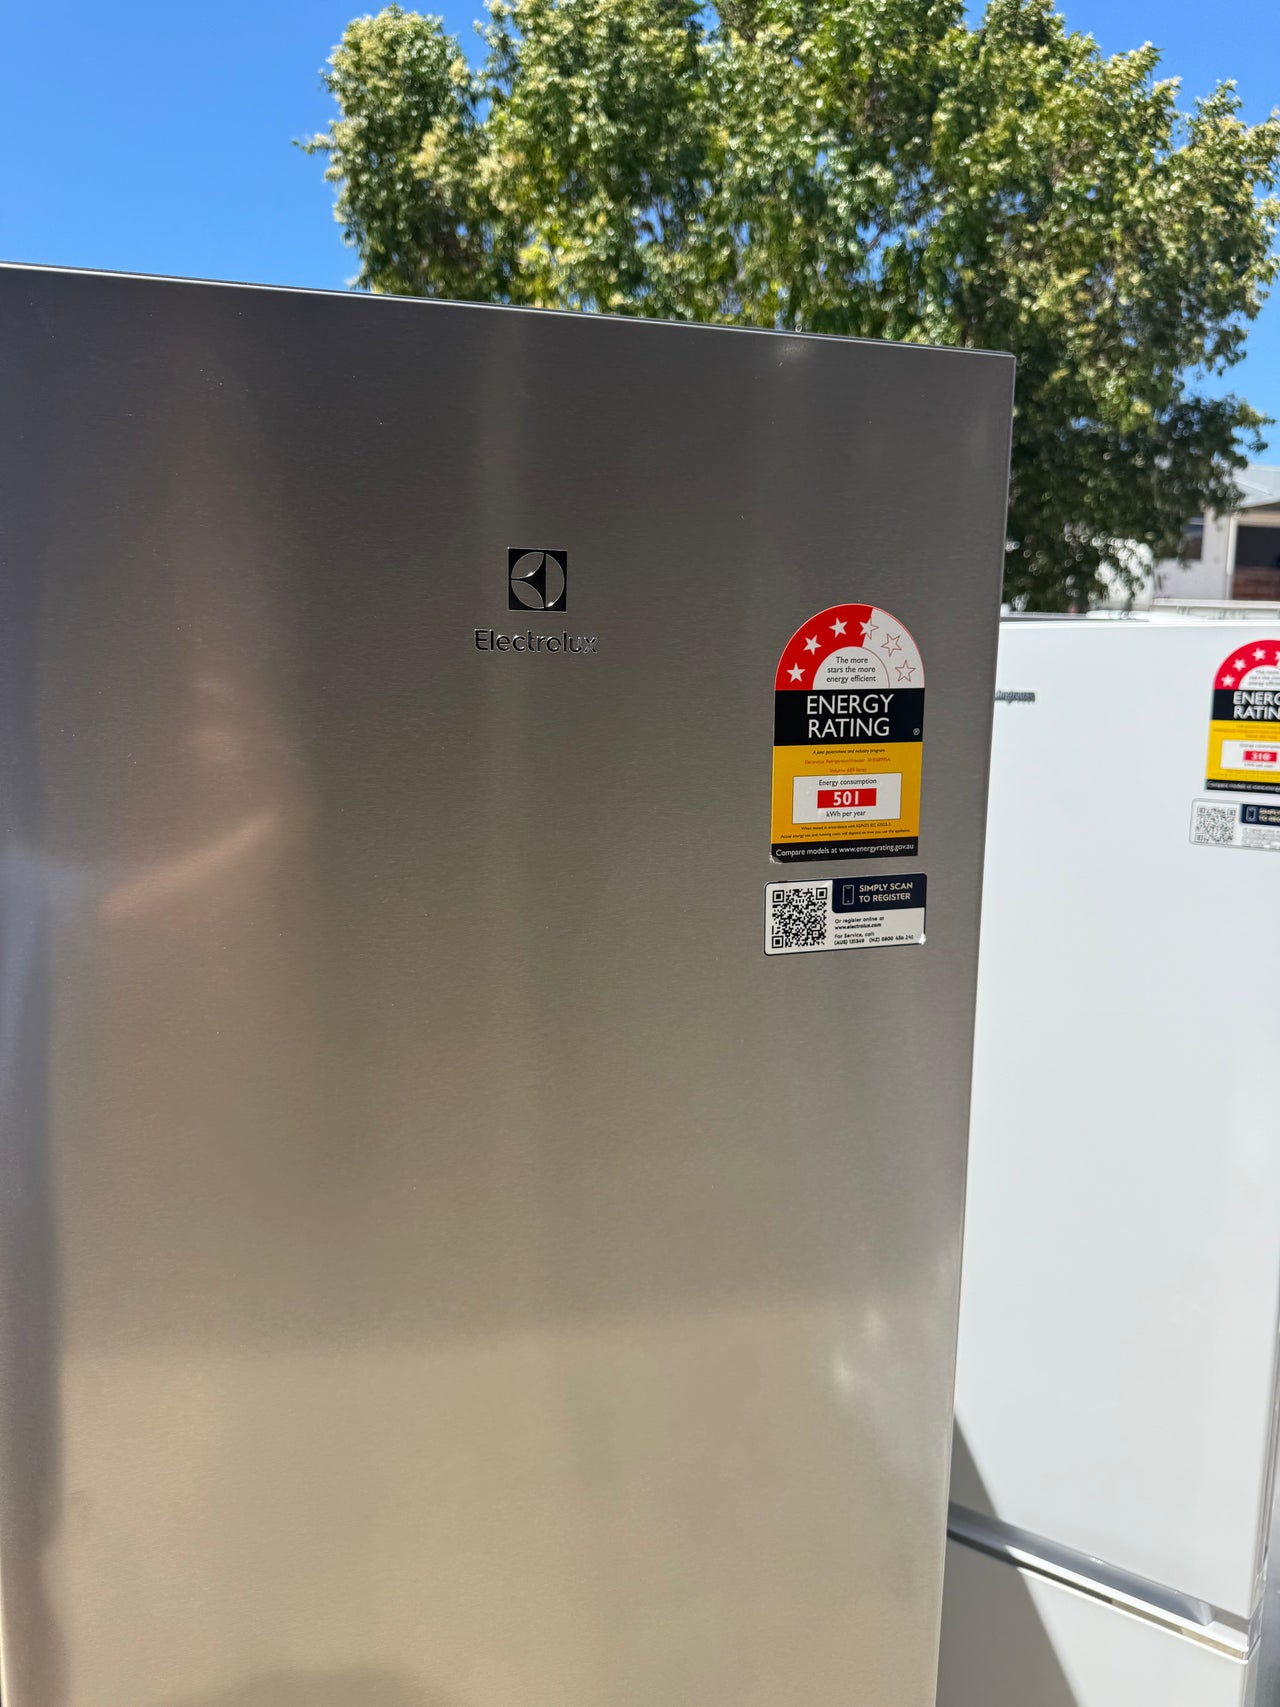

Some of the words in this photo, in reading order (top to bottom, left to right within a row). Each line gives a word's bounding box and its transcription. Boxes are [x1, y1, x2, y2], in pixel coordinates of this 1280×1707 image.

[474, 628, 598, 653] Electrolux
[835, 656, 849, 664] The
[826, 676, 848, 684] energy
[806, 694, 894, 715] ENERGY
[808, 717, 890, 738] RATING
[818, 779, 838, 787] Energy
[840, 778, 877, 786] consumption
[833, 790, 859, 806] 501
[853, 810, 866, 818] year
[775, 849, 805, 858] Compare
[806, 847, 829, 855] models
[838, 844, 914, 853] www.energyrating.gov.au
[859, 884, 888, 892] SIMPLY
[889, 882, 913, 890] SCAN
[859, 895, 870, 903] TO
[872, 892, 911, 902] REGISTER
